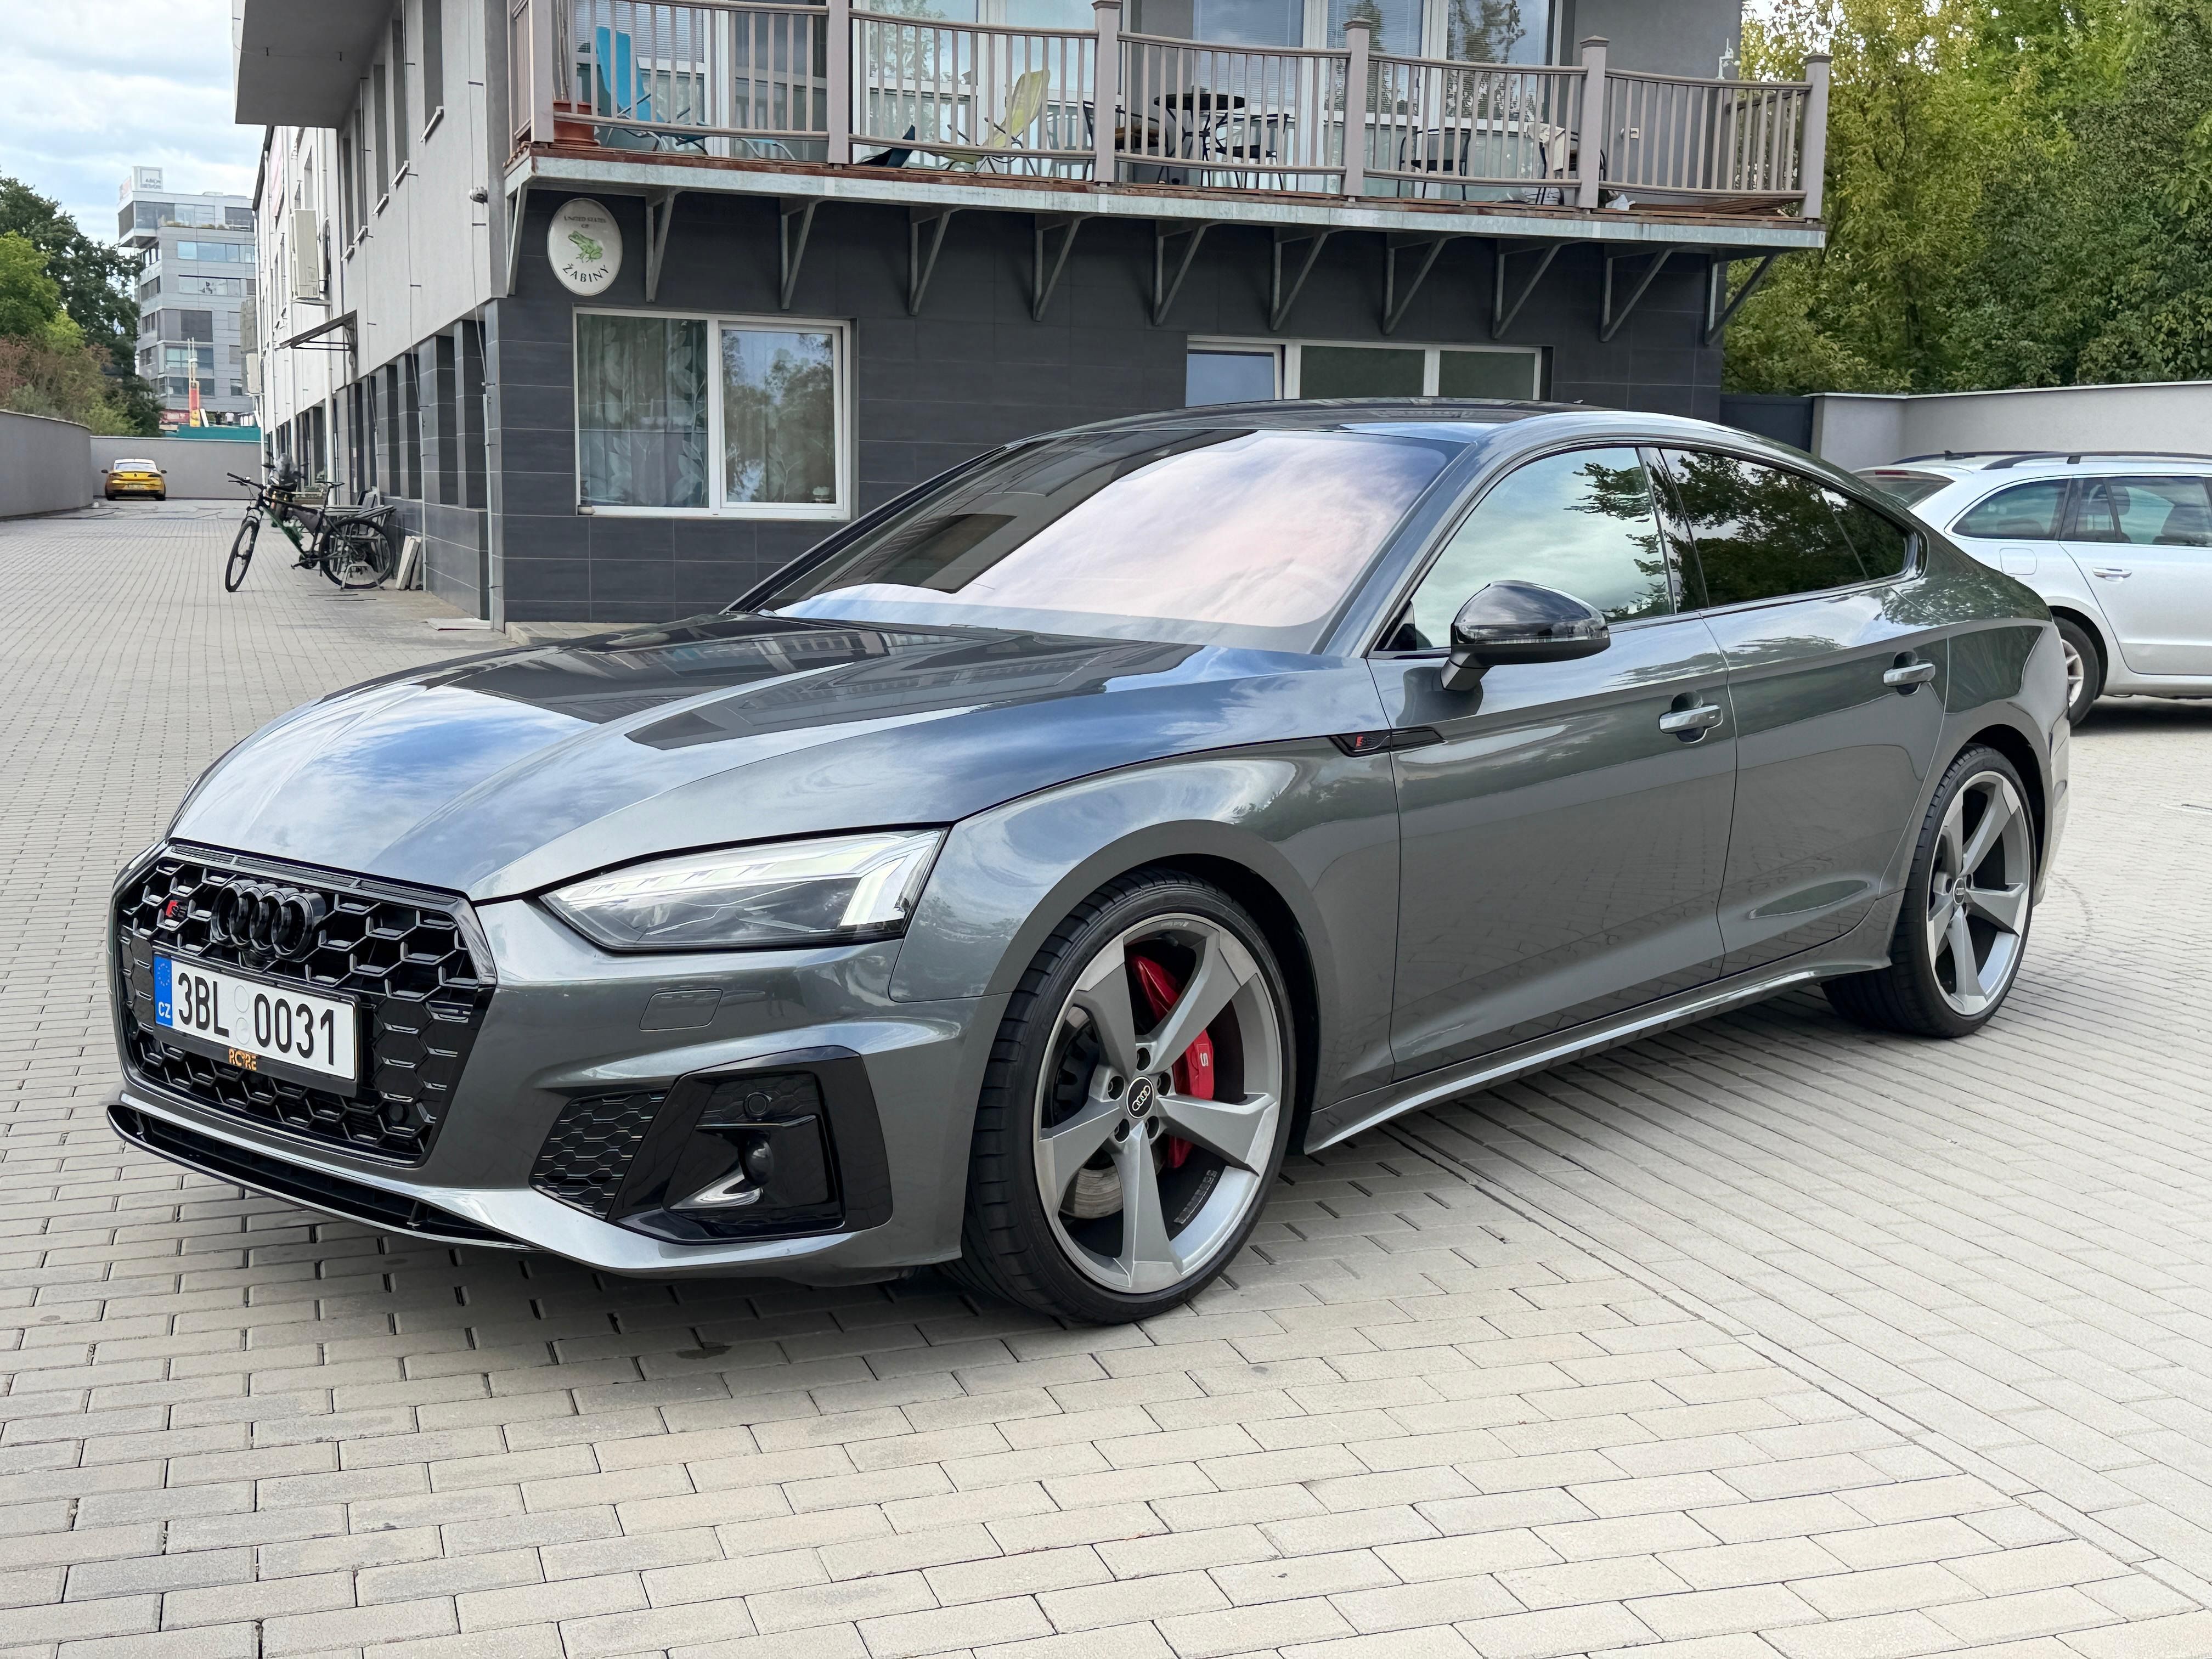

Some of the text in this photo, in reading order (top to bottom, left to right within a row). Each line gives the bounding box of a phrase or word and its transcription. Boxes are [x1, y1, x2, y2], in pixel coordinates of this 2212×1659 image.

[157, 1001, 171, 1019] CZ
[178, 972, 334, 1066] 3BL 0031
